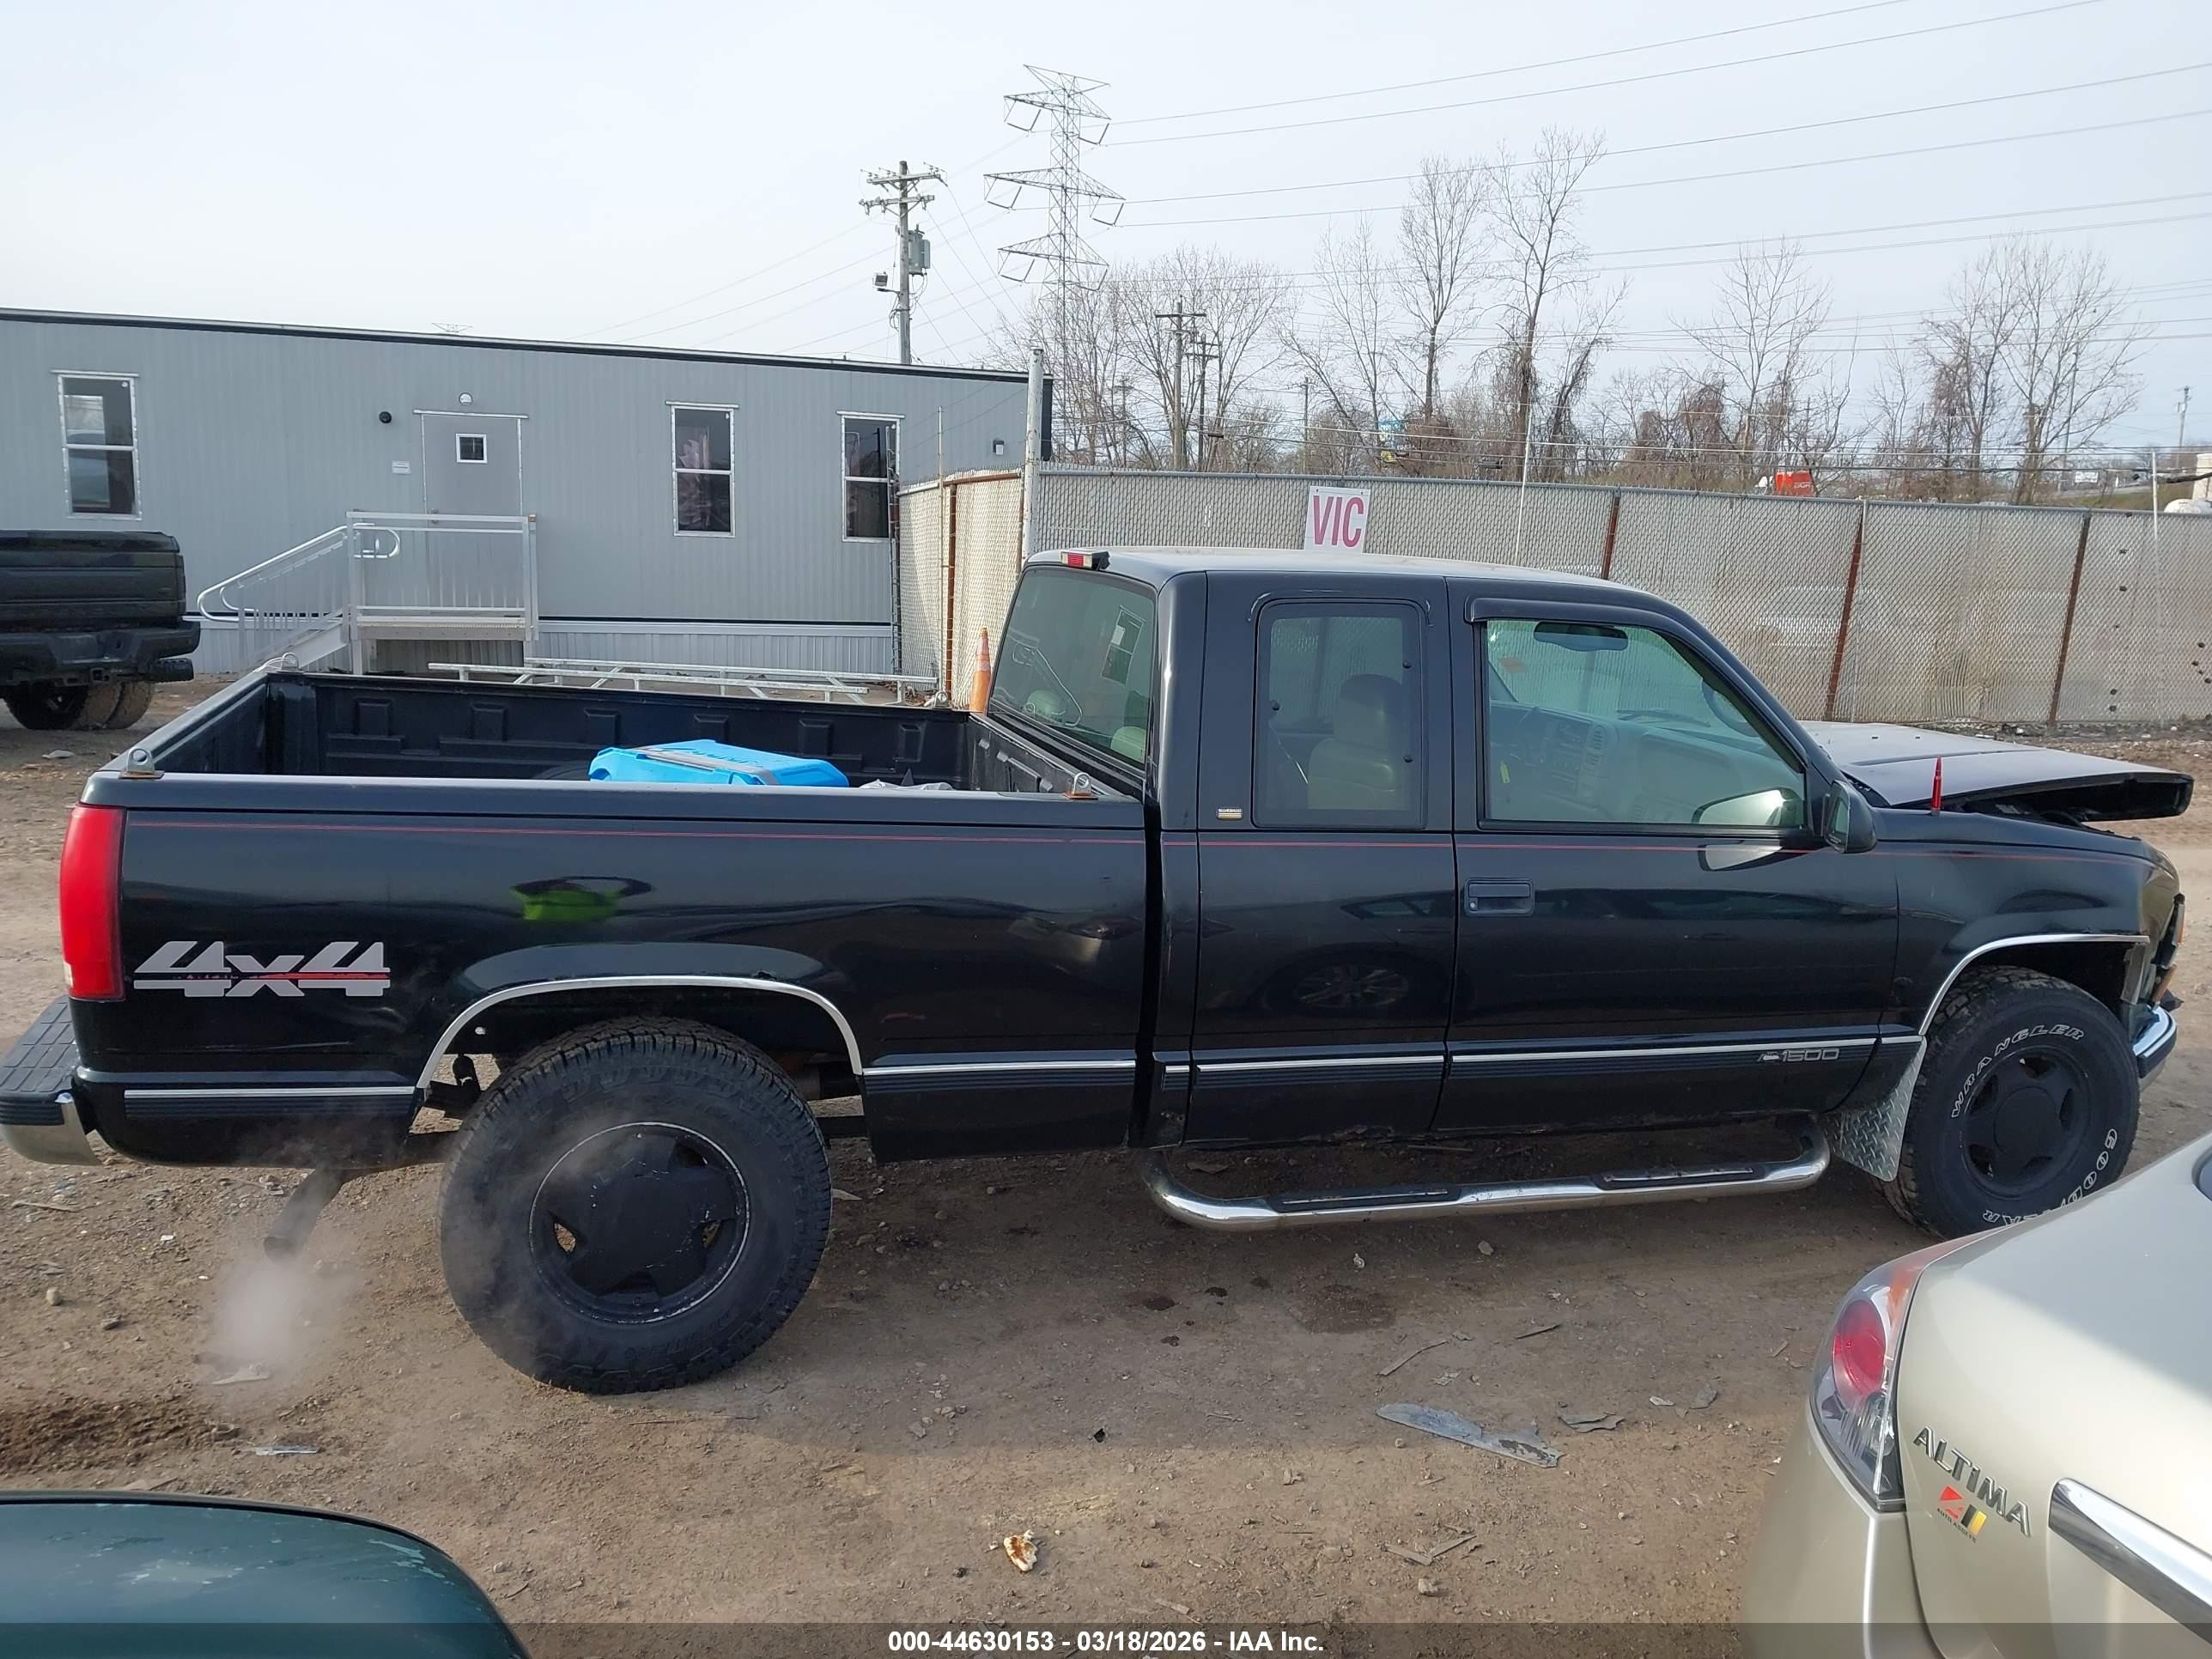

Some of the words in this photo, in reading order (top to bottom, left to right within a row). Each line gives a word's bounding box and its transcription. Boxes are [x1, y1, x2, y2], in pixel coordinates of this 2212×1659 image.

[1313, 495, 1364, 548] VIC
[1782, 1048, 1840, 1062] 1500
[1951, 1024, 2085, 1118] WRANGLER
[1982, 1127, 2118, 1226] GOODAR
[1913, 1425, 2032, 1538] ALTIMA
